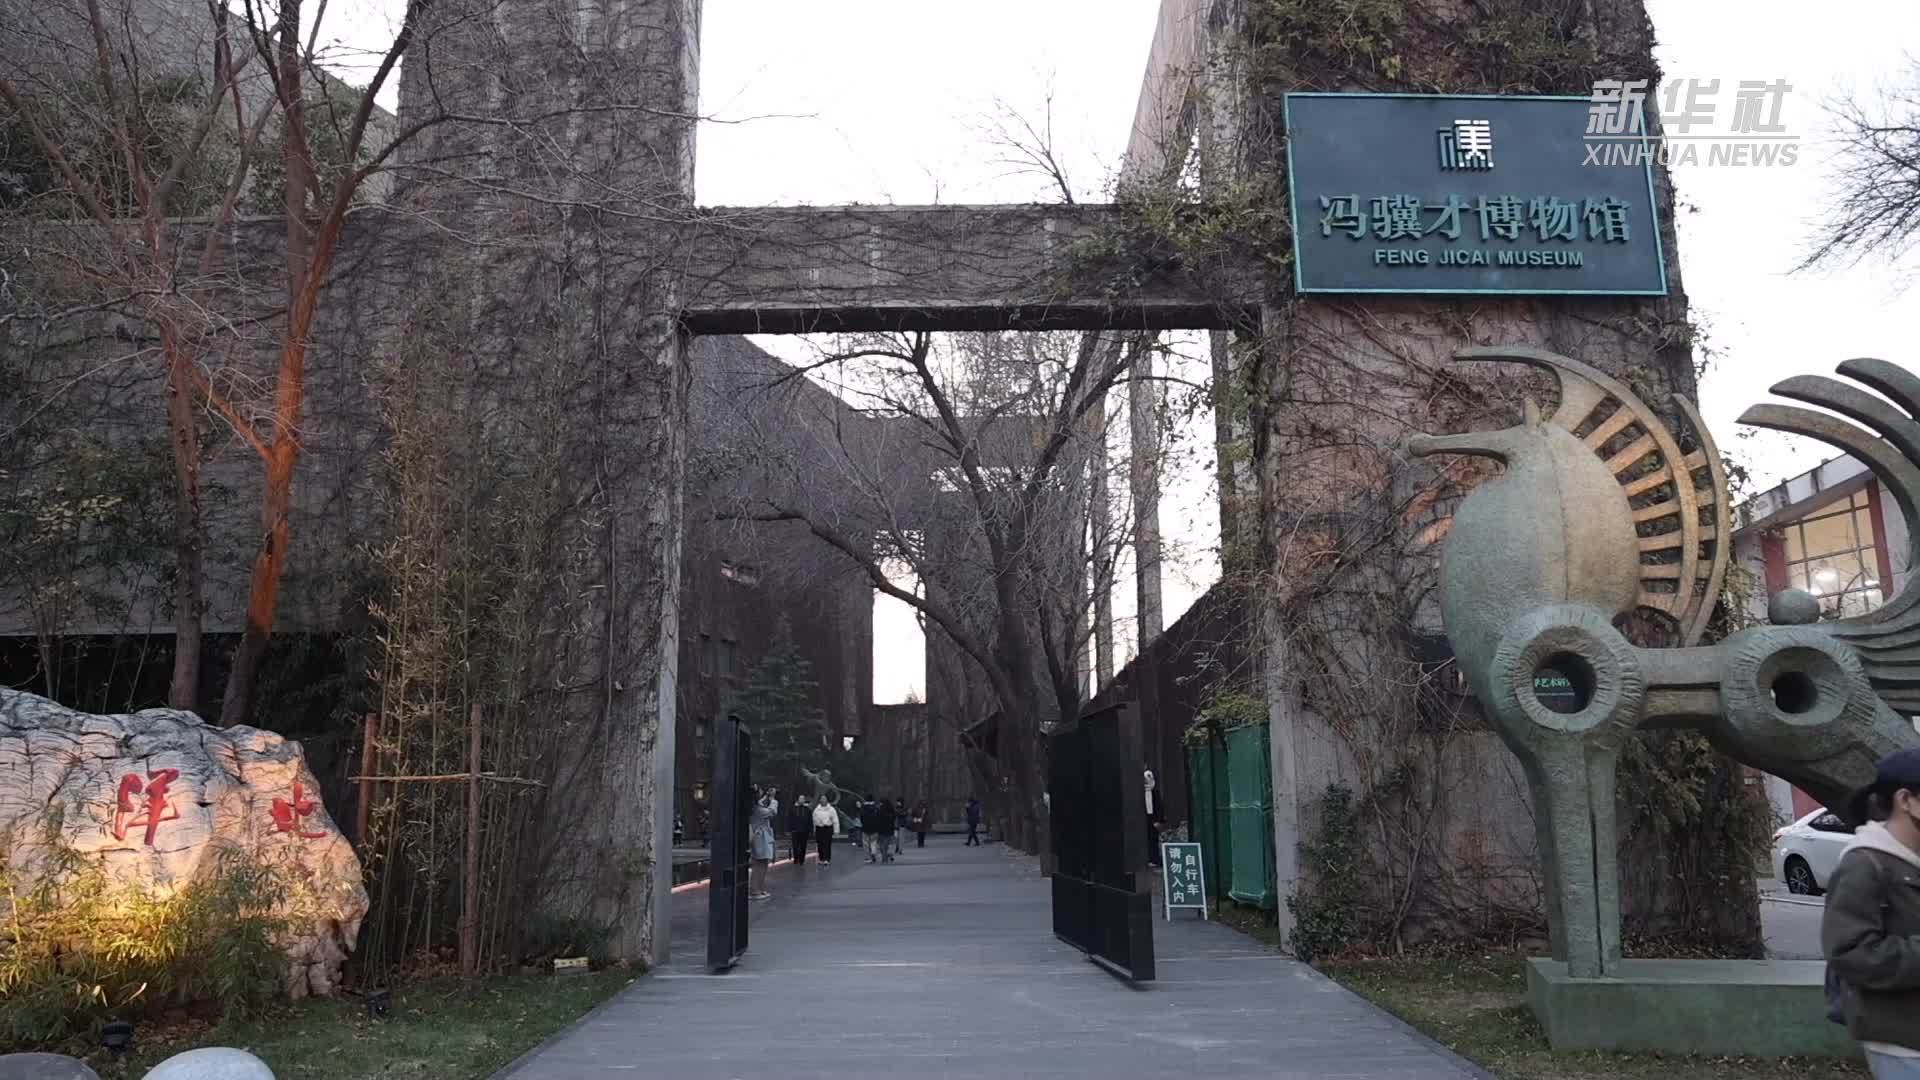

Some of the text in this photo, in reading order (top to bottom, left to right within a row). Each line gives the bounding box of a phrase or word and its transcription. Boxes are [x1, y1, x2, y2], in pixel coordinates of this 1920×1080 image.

[1320, 194, 1632, 241] 冯骥才博物馆
[1375, 249, 1584, 266] FENG JICAI MUSEUM
[1168, 847, 1185, 903] 请勿入内
[1185, 854, 1200, 897] 自行车
